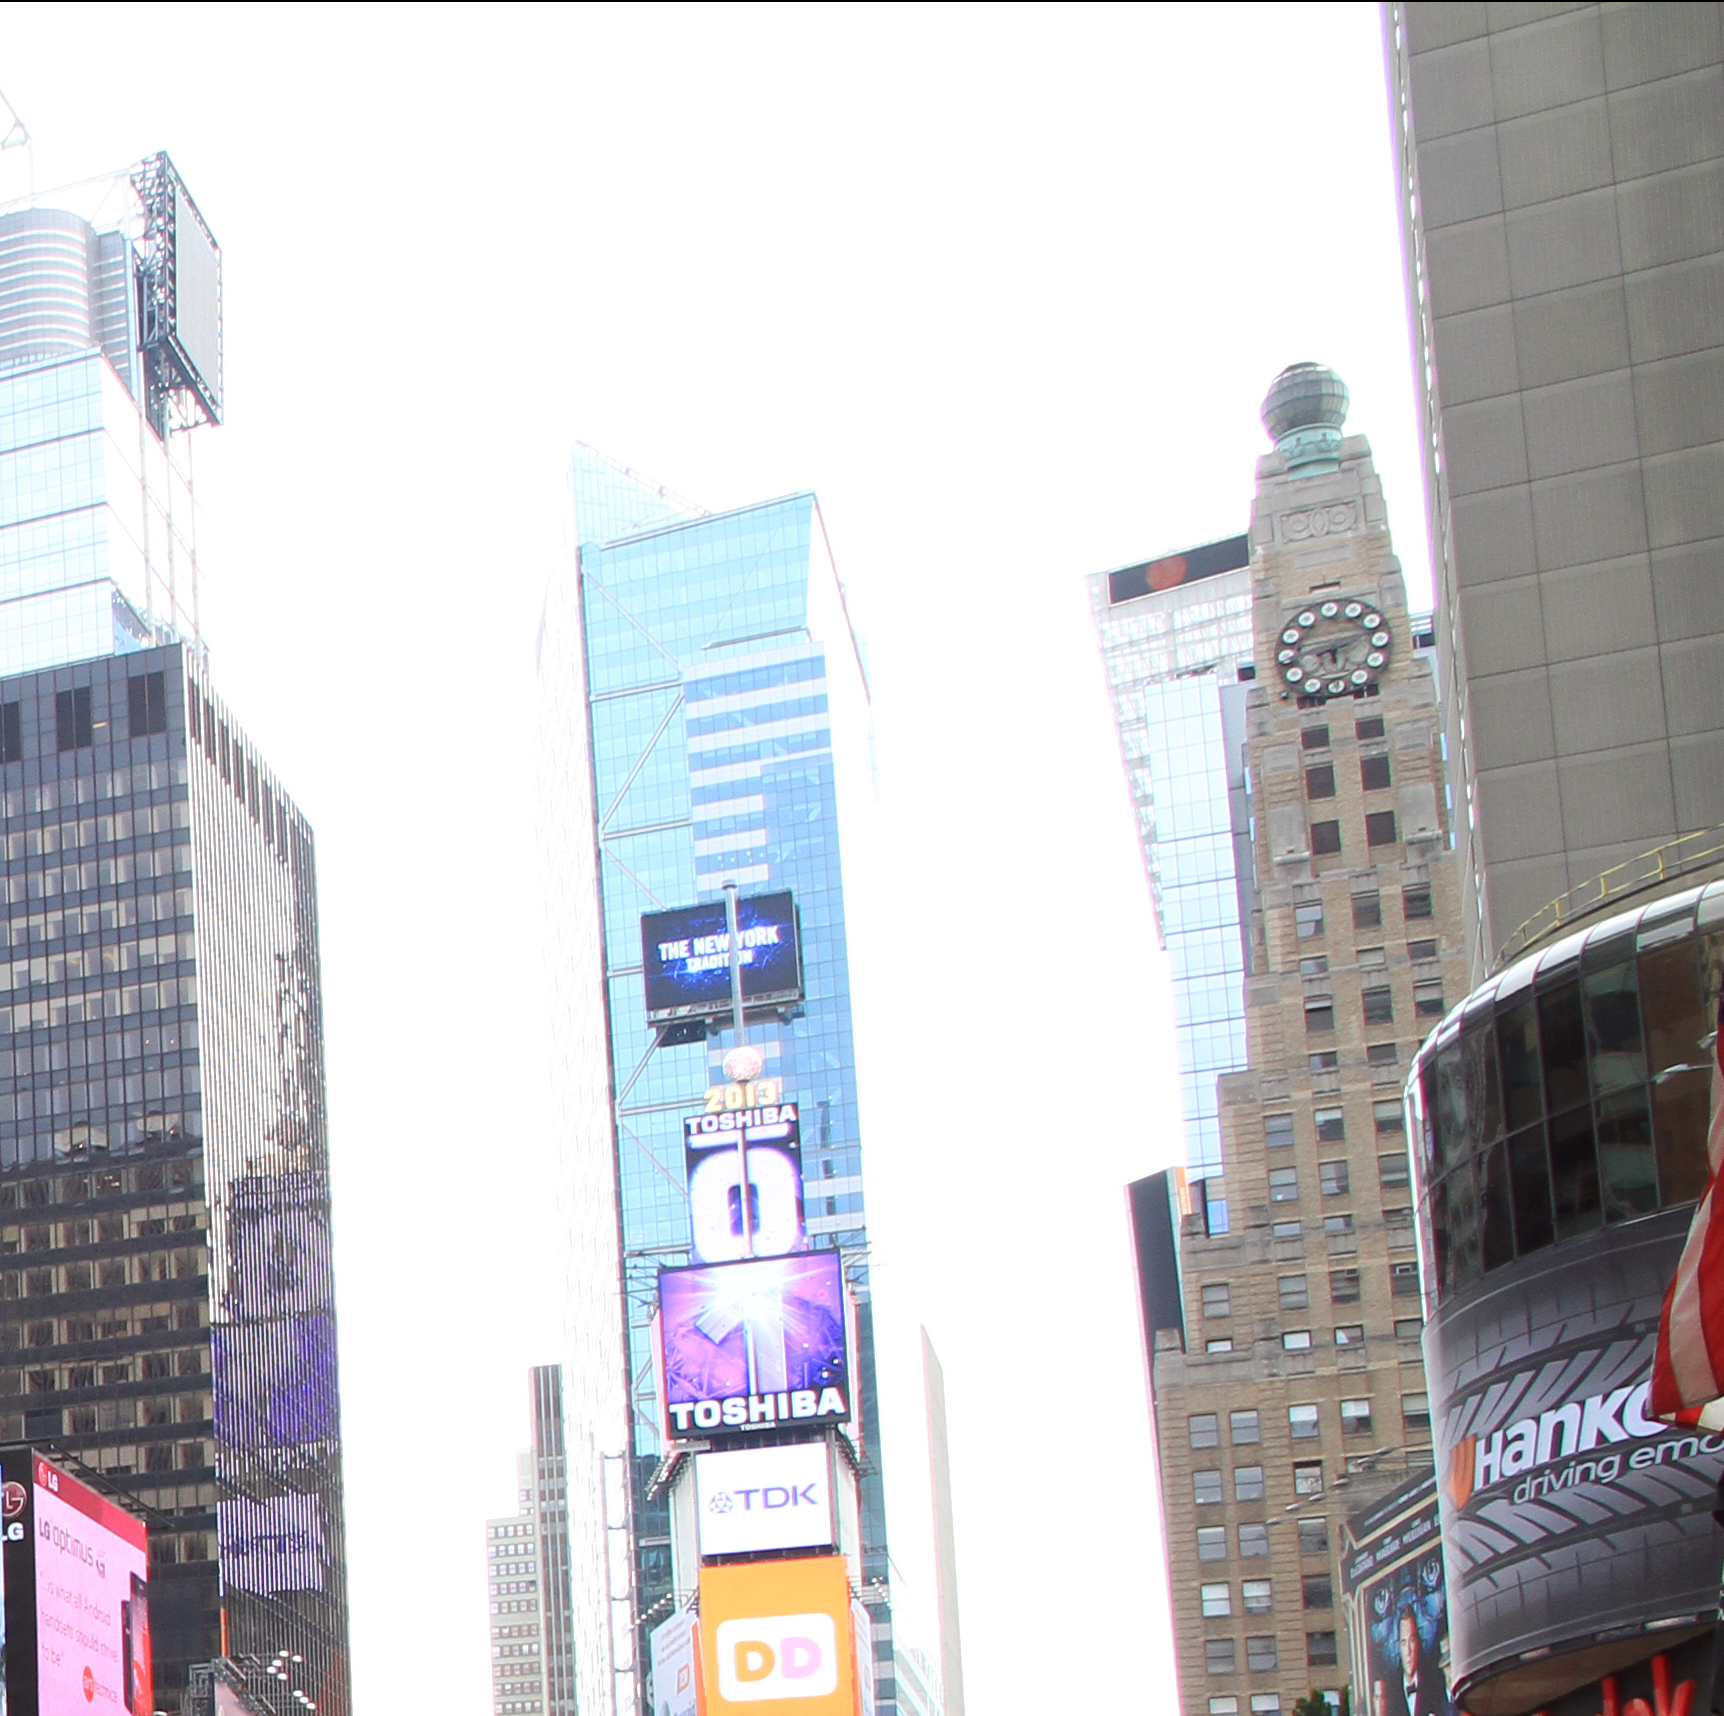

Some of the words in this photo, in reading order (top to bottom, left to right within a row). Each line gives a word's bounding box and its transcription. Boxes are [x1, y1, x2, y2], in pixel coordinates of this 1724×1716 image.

[658, 939, 690, 961] THE
[693, 933, 730, 955] NEW
[736, 925, 780, 949] YORK
[704, 1080, 778, 1113] 2013
[686, 1103, 797, 1134] TOSHIBA
[669, 1386, 847, 1430] TOSHIBA
[48, 1471, 59, 1492] LG
[733, 1483, 819, 1511] TDK
[1513, 1458, 1621, 1506] driving
[38, 1517, 51, 1541] LG
[52, 1526, 94, 1567] optimus
